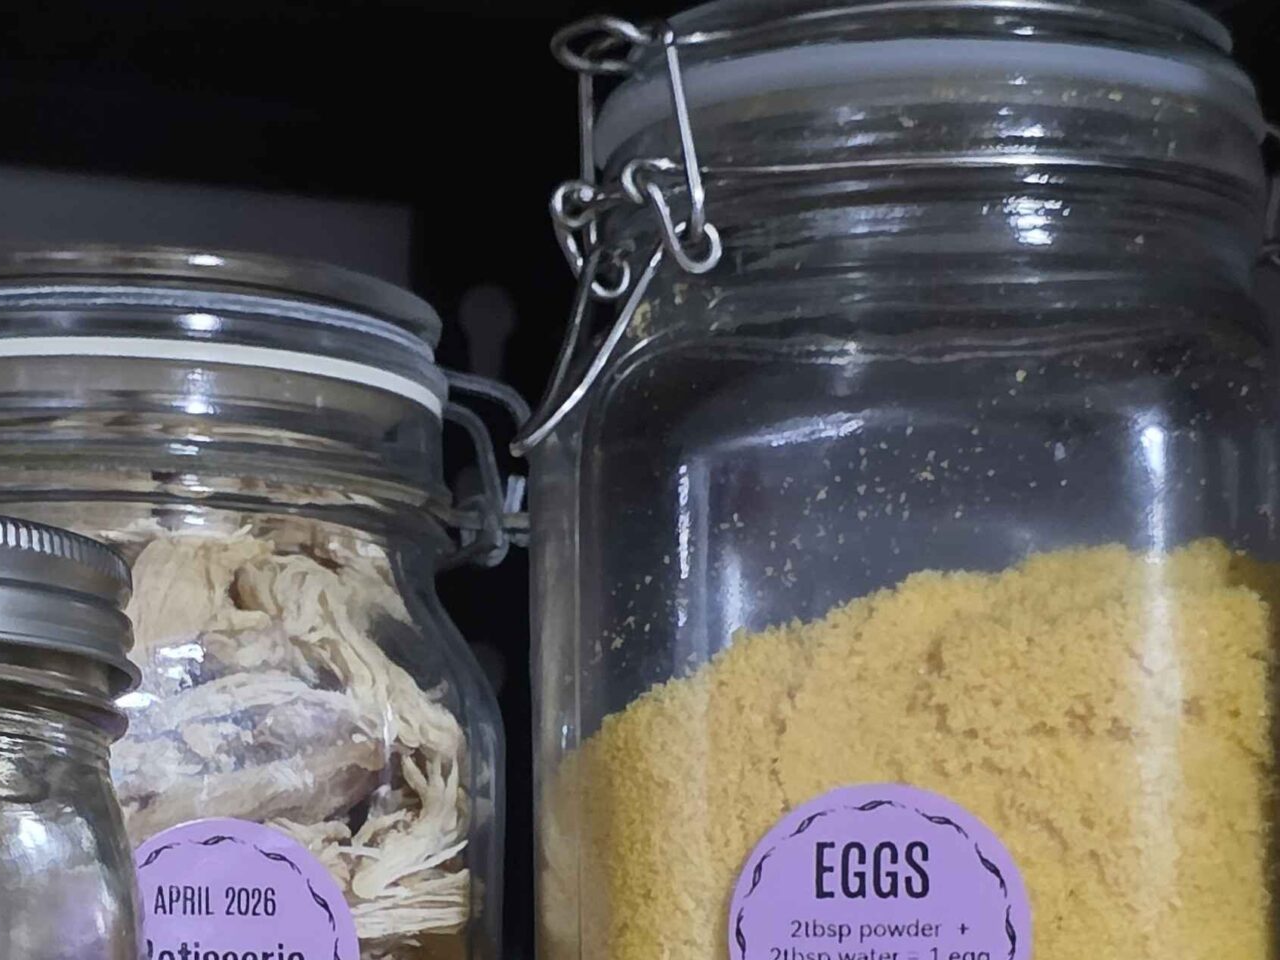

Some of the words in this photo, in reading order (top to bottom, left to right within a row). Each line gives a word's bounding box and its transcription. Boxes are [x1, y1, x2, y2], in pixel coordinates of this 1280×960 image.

[815, 840, 930, 900] EGGS
[154, 885, 214, 916] APRIL
[225, 886, 277, 917] 2026
[859, 919, 942, 944] powder
